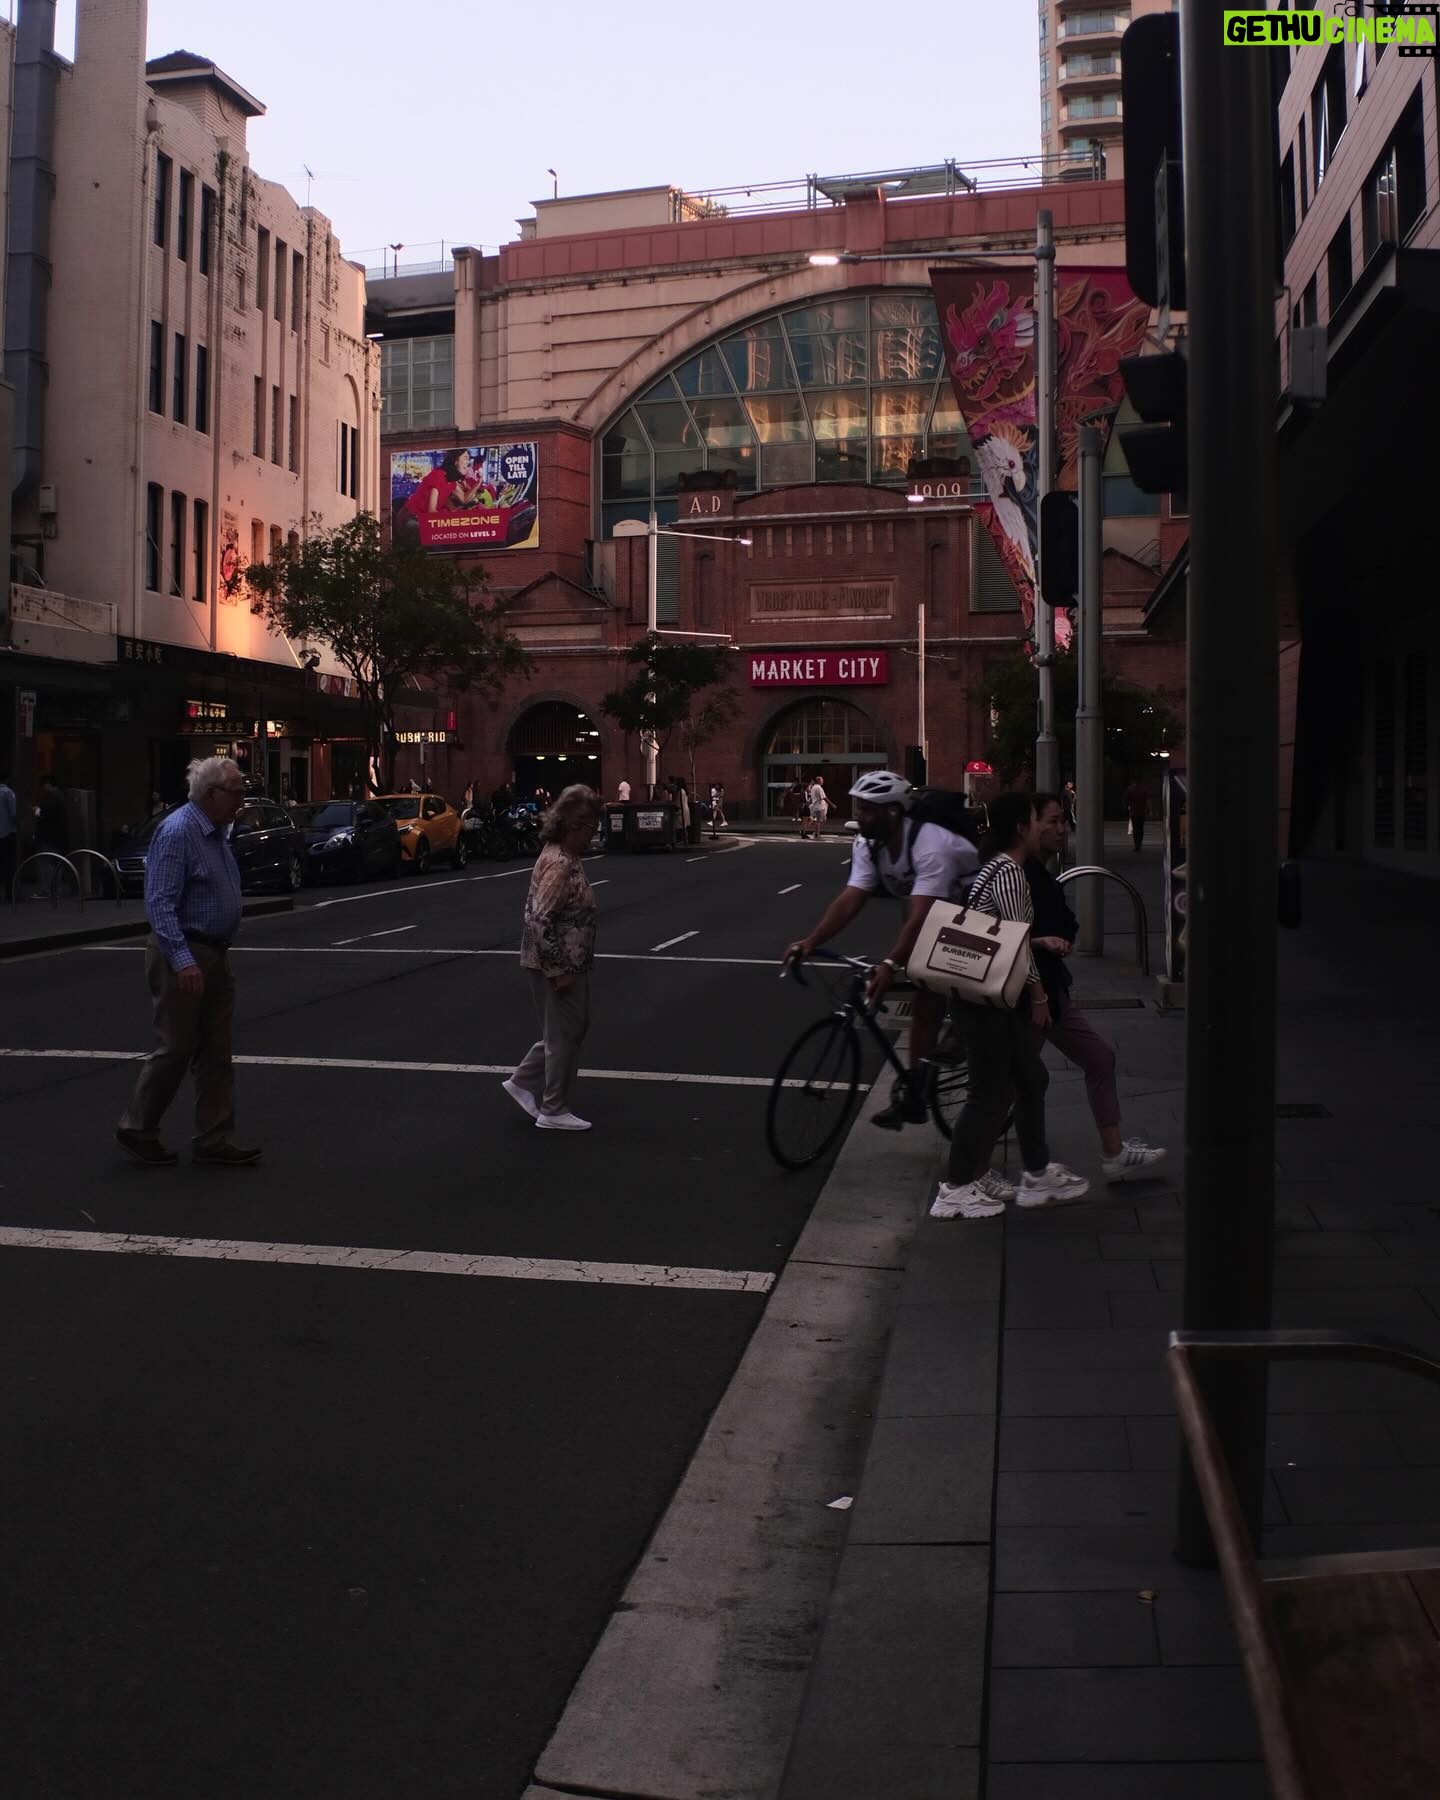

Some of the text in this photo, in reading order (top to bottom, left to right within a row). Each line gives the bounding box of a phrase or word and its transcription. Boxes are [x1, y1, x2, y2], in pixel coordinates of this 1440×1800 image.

[505, 455, 529, 464] OPEN
[508, 464, 526, 472] TILL
[507, 471, 528, 479] LATE
[914, 482, 961, 497] 1909
[428, 515, 500, 528] TIMEZONE
[431, 532, 458, 541] LOCATED
[470, 530, 490, 538] LEVEL
[752, 657, 880, 680] MARKET CITY
[428, 731, 446, 742] RIO
[942, 946, 982, 960] BURBERRY
